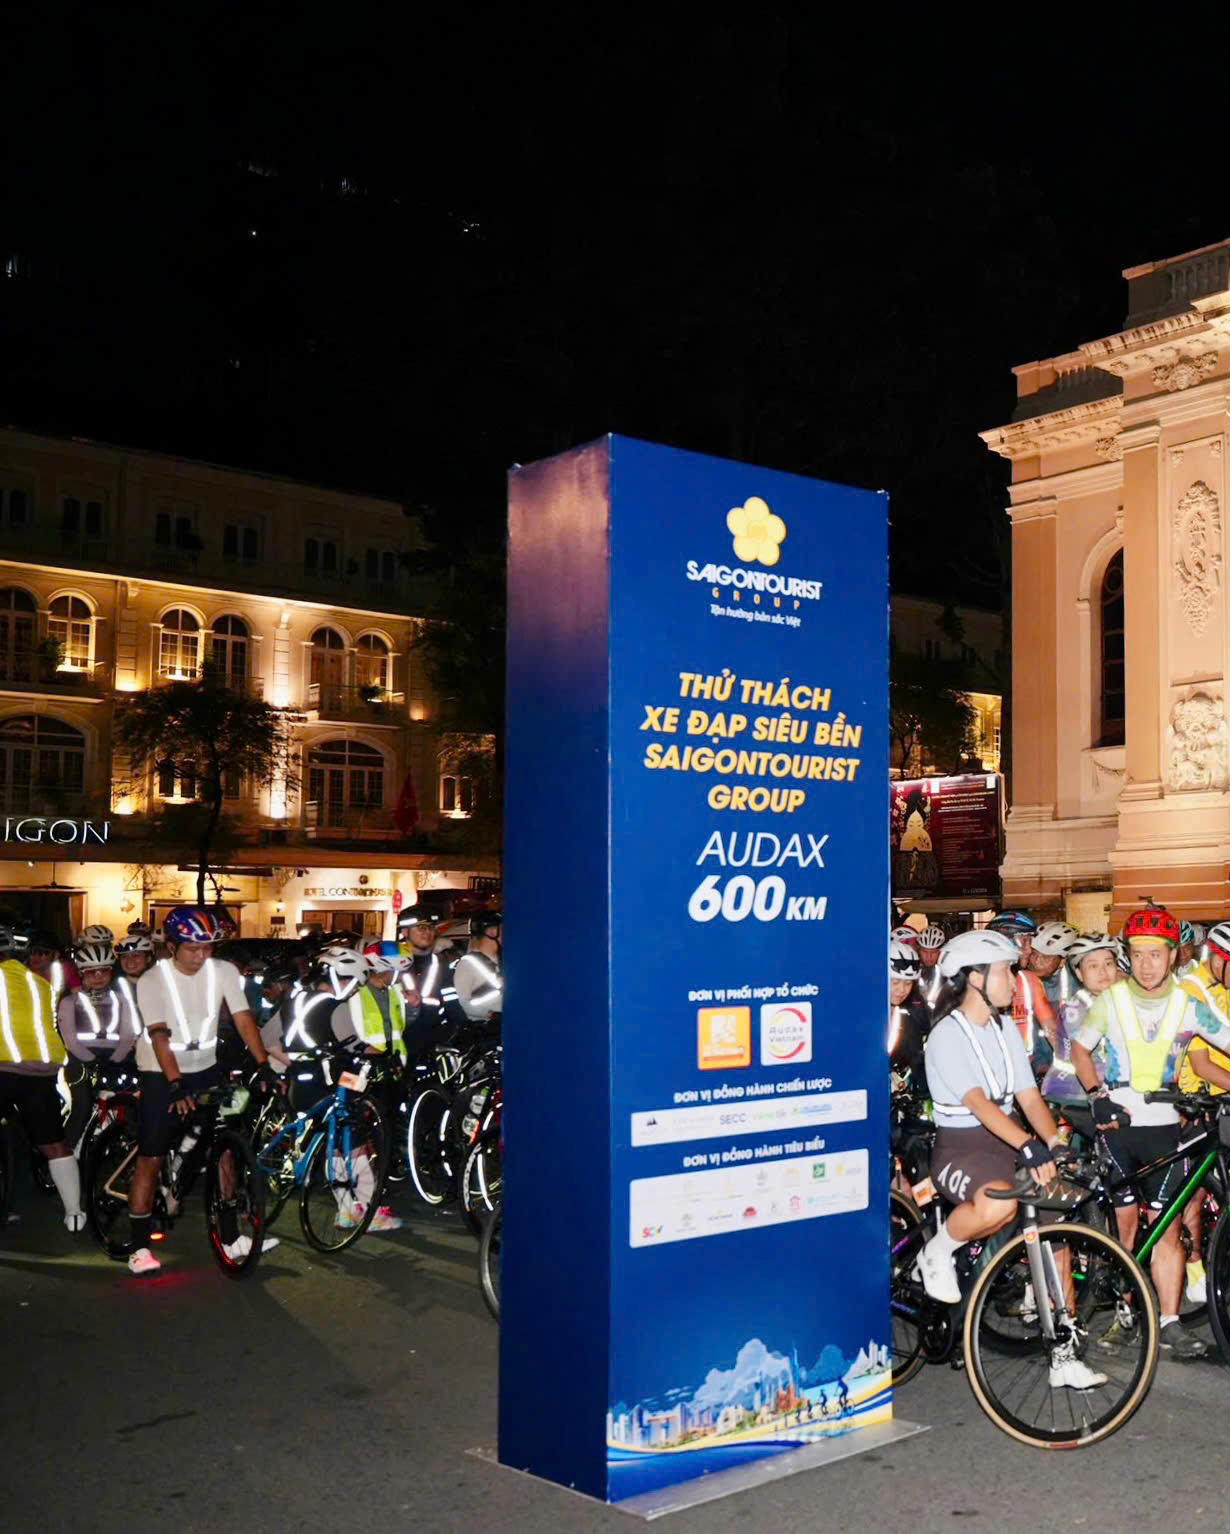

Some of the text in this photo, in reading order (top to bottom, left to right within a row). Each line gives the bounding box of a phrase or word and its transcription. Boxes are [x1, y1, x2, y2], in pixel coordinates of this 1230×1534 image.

[686, 560, 823, 600] SAIGONTOURIST
[712, 587, 800, 610] GROUP
[679, 668, 832, 712] THỬ THÁCH
[639, 705, 863, 748] XE ĐẠP SIÊU BỀN
[643, 743, 860, 782] SAIGONTOURIST
[708, 784, 806, 813] GROUP
[4, 817, 111, 844] IGON
[695, 830, 830, 868] AUDAX
[688, 874, 828, 923] 600 KM
[673, 1091, 699, 1103] ĐƠN
[700, 1090, 712, 1103] VỊ
[746, 1081, 775, 1096] HÀNH
[719, 1112, 747, 1125] SECC
[683, 1154, 708, 1167] ĐƠN
[709, 1153, 720, 1166] VỊ
[754, 1141, 784, 1158] HÀNH
